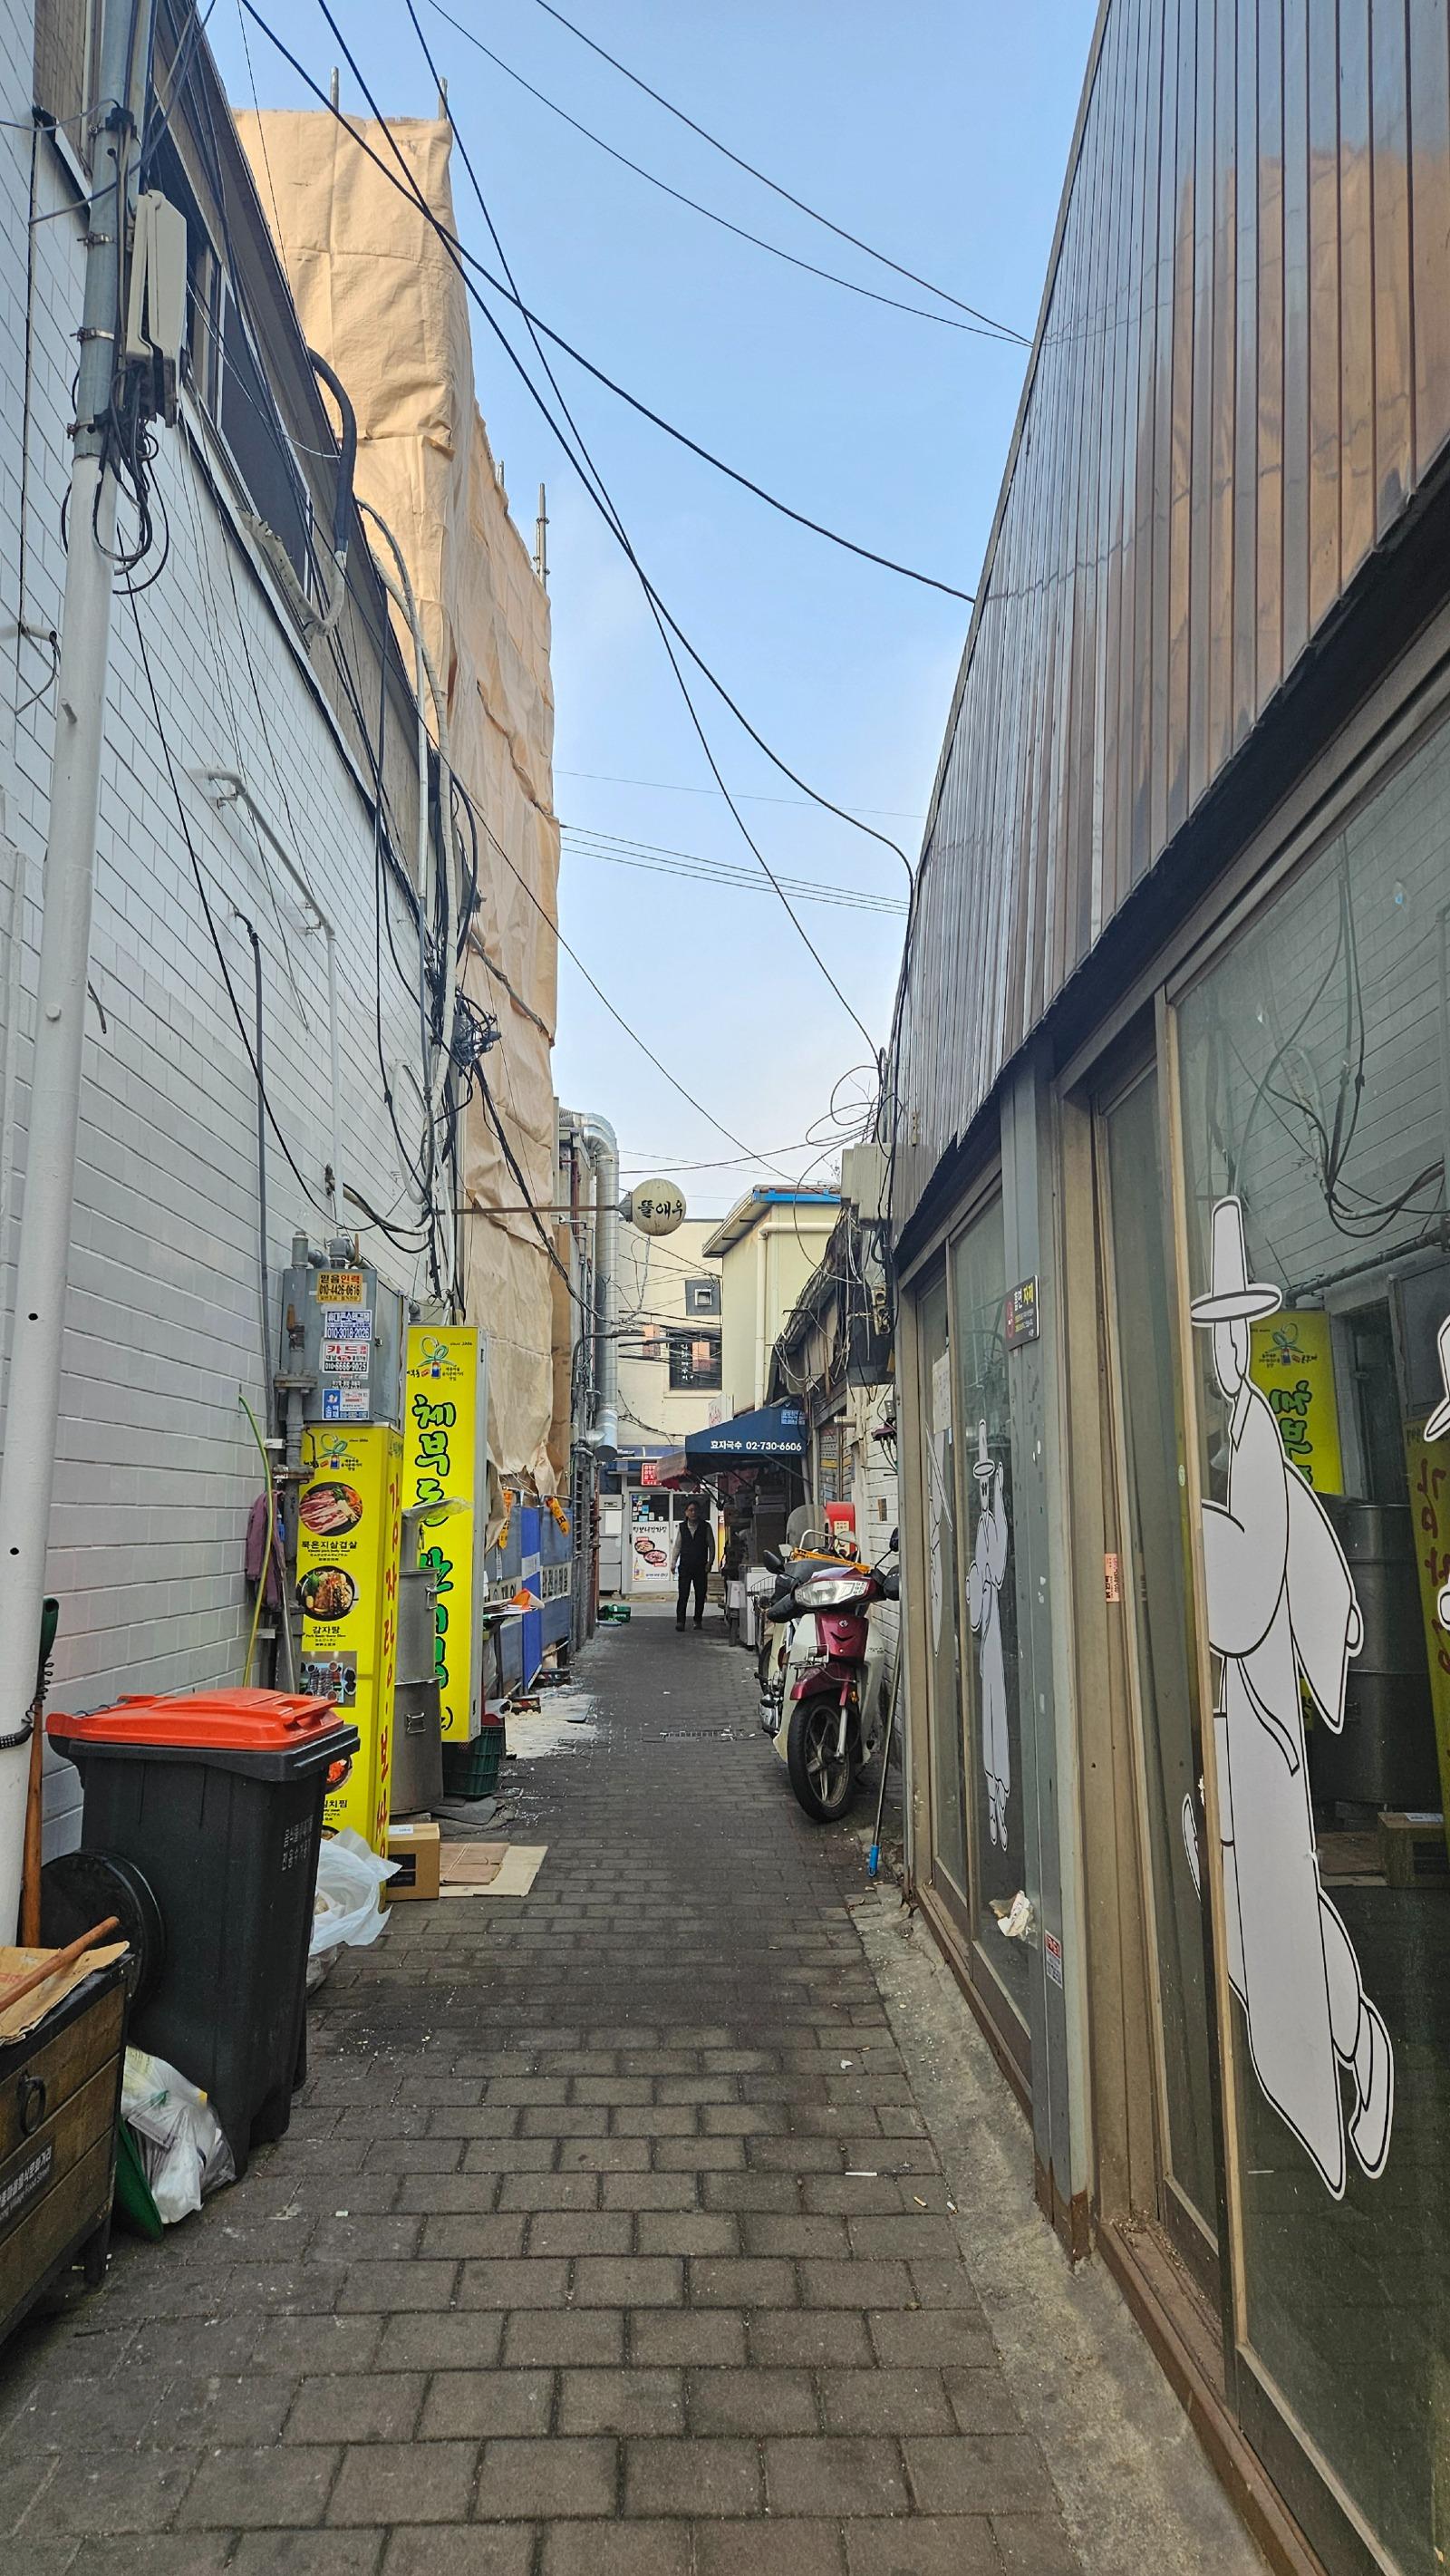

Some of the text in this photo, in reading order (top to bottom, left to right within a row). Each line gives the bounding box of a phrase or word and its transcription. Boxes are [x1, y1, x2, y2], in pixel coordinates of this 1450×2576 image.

[327, 1327, 370, 1339] 010-3018-2026
[710, 1440, 802, 1451] 효자국수 02-730-6606
[302, 1541, 357, 1549] 묵은지삼겹살
[313, 1626, 340, 1634] 감자탕
